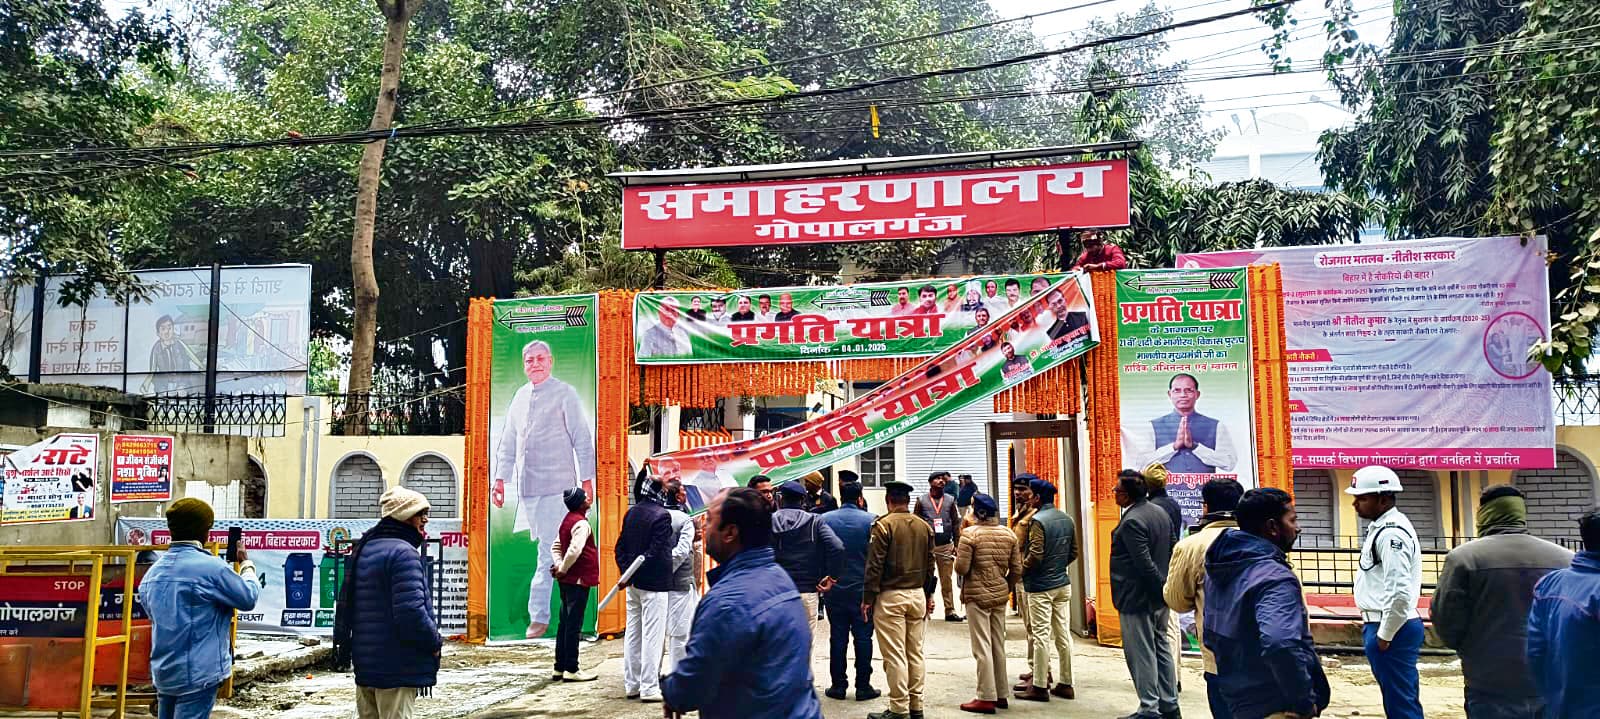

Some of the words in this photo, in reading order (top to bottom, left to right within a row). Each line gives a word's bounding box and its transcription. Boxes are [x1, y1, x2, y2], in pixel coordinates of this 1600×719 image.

[638, 165, 1112, 221] समाहरणालय
[754, 212, 965, 240] गोपालगंज
[1320, 252, 1351, 266] रोजगार
[1353, 252, 1383, 265] मतलब
[1392, 250, 1421, 263] नीतीश
[1424, 250, 1456, 262] सरकार
[1343, 272, 1360, 282] बिहार
[1403, 269, 1412, 280] की
[1414, 271, 1430, 279] बहार
[1120, 296, 1184, 324] प्रगति
[1186, 300, 1242, 321] यात्रा
[1332, 315, 1341, 326] श्री
[1343, 315, 1365, 326] नीतीश
[1367, 316, 1387, 327] कुमार
[728, 315, 840, 347] प्रगति
[847, 313, 946, 341] यात्रा
[1150, 326, 1159, 334] के
[1163, 325, 1199, 333] आगमन
[1153, 337, 1162, 346] के
[1197, 336, 1223, 346] विकास
[841, 342, 887, 354] 04.01.2025
[1137, 351, 1168, 360] माननीय
[1168, 350, 1202, 362] मुख्यमंत्री
[1203, 349, 1214, 359] जी
[1215, 350, 1227, 359] का
[1124, 362, 1148, 372] हार्दिक
[1152, 361, 1191, 372] अभिनन्दन
[1195, 361, 1208, 372] एवं
[1211, 362, 1238, 371] स्वागत
[750, 412, 873, 475] प्रगति
[874, 362, 981, 421] यात्रा
[32, 444, 92, 465] राटे
[1338, 451, 1368, 465] विभाग
[1371, 451, 1416, 465] गोपालगंज
[1418, 454, 1437, 467] द्वारा
[1440, 451, 1472, 467] जनहित
[1473, 451, 1482, 465] में
[1483, 451, 1520, 465] प्रचारित
[265, 533, 287, 547] बिहार
[287, 536, 316, 547] सरकार
[54, 581, 85, 591] STOP
[237, 613, 264, 622] वच्छता
